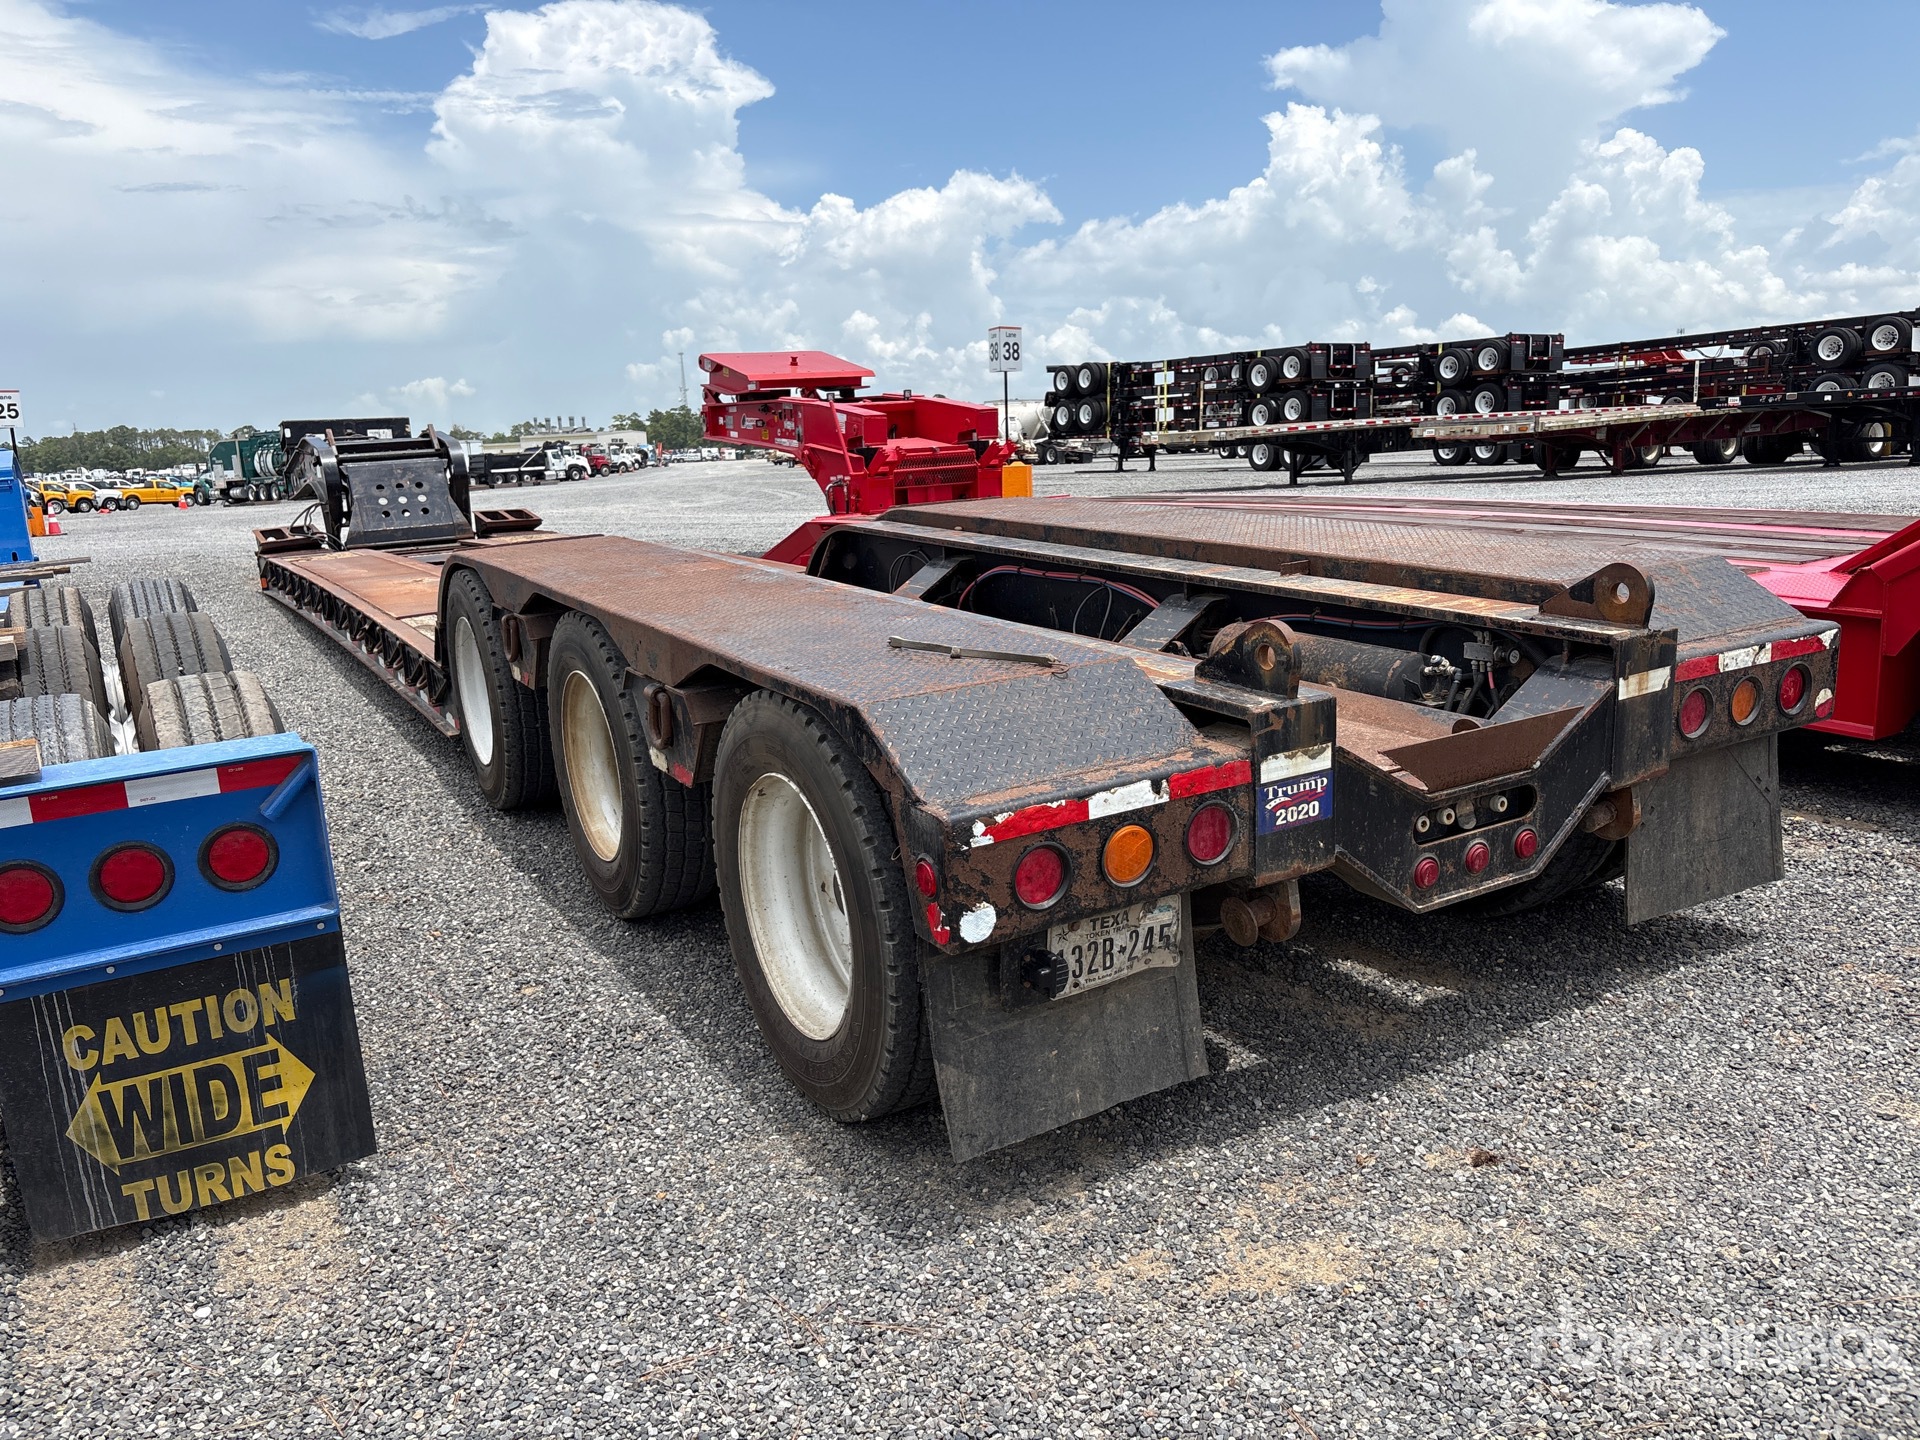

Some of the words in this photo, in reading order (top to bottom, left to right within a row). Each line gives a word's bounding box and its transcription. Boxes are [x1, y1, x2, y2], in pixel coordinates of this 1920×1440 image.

[989, 342, 999, 362] 38
[1002, 341, 1020, 361] 38
[0, 403, 19, 419] 25
[1264, 777, 1328, 800] Trump
[1275, 800, 1320, 826] 2020
[1089, 910, 1130, 932] TEXA
[1085, 929, 1110, 939] TOKEN
[1058, 937, 1115, 979] 32B
[1127, 923, 1173, 962] 245
[62, 978, 297, 1071] CAUTION
[97, 1048, 291, 1163] WIDE
[121, 1143, 296, 1221] TURNS
